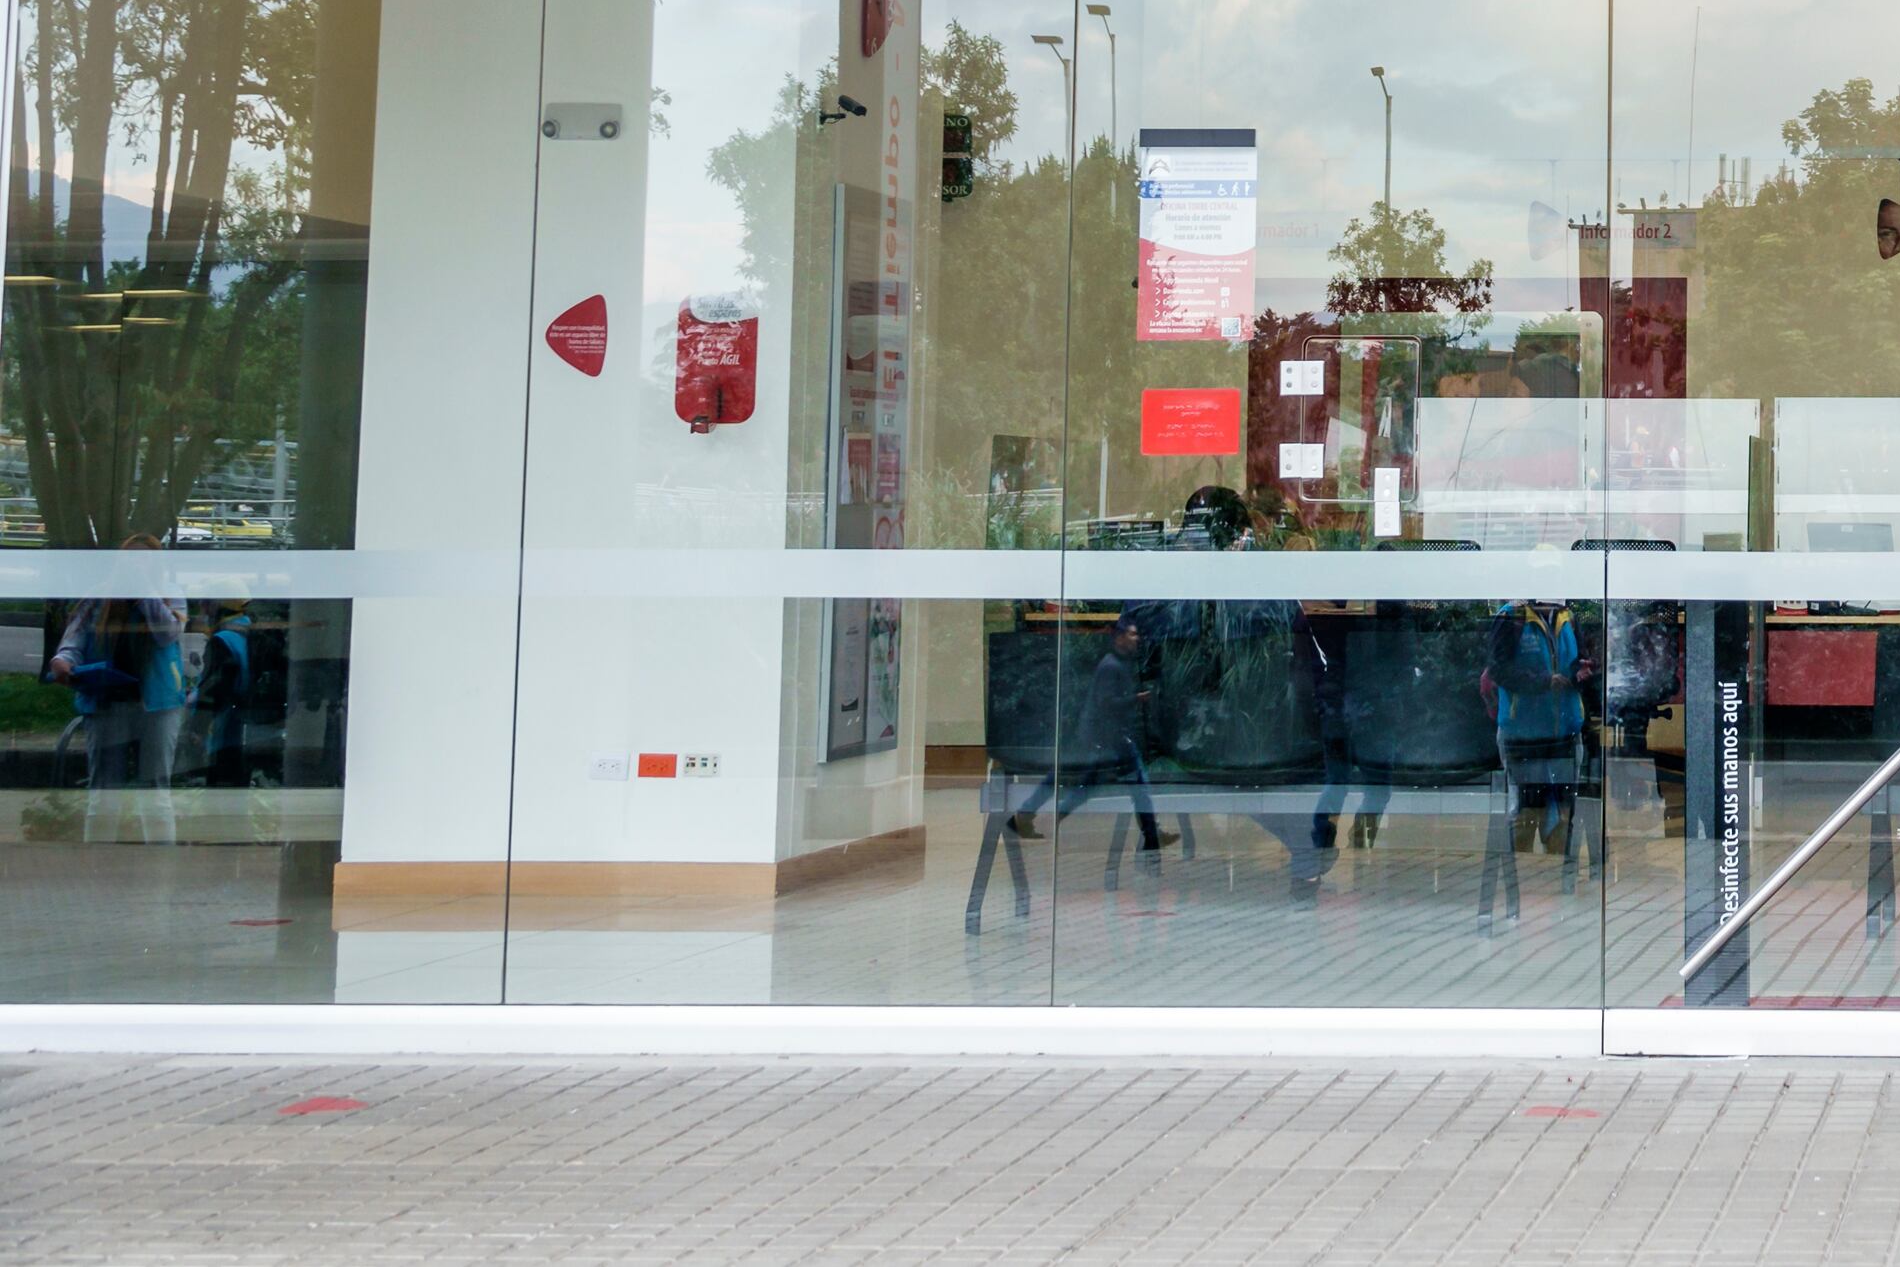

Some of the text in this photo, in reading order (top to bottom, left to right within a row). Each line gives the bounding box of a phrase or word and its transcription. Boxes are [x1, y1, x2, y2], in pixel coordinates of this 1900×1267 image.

[1663, 223, 1672, 239] 2
[1718, 681, 1743, 723] aquí
[1724, 727, 1739, 789] manos
[1724, 793, 1739, 823] sus
